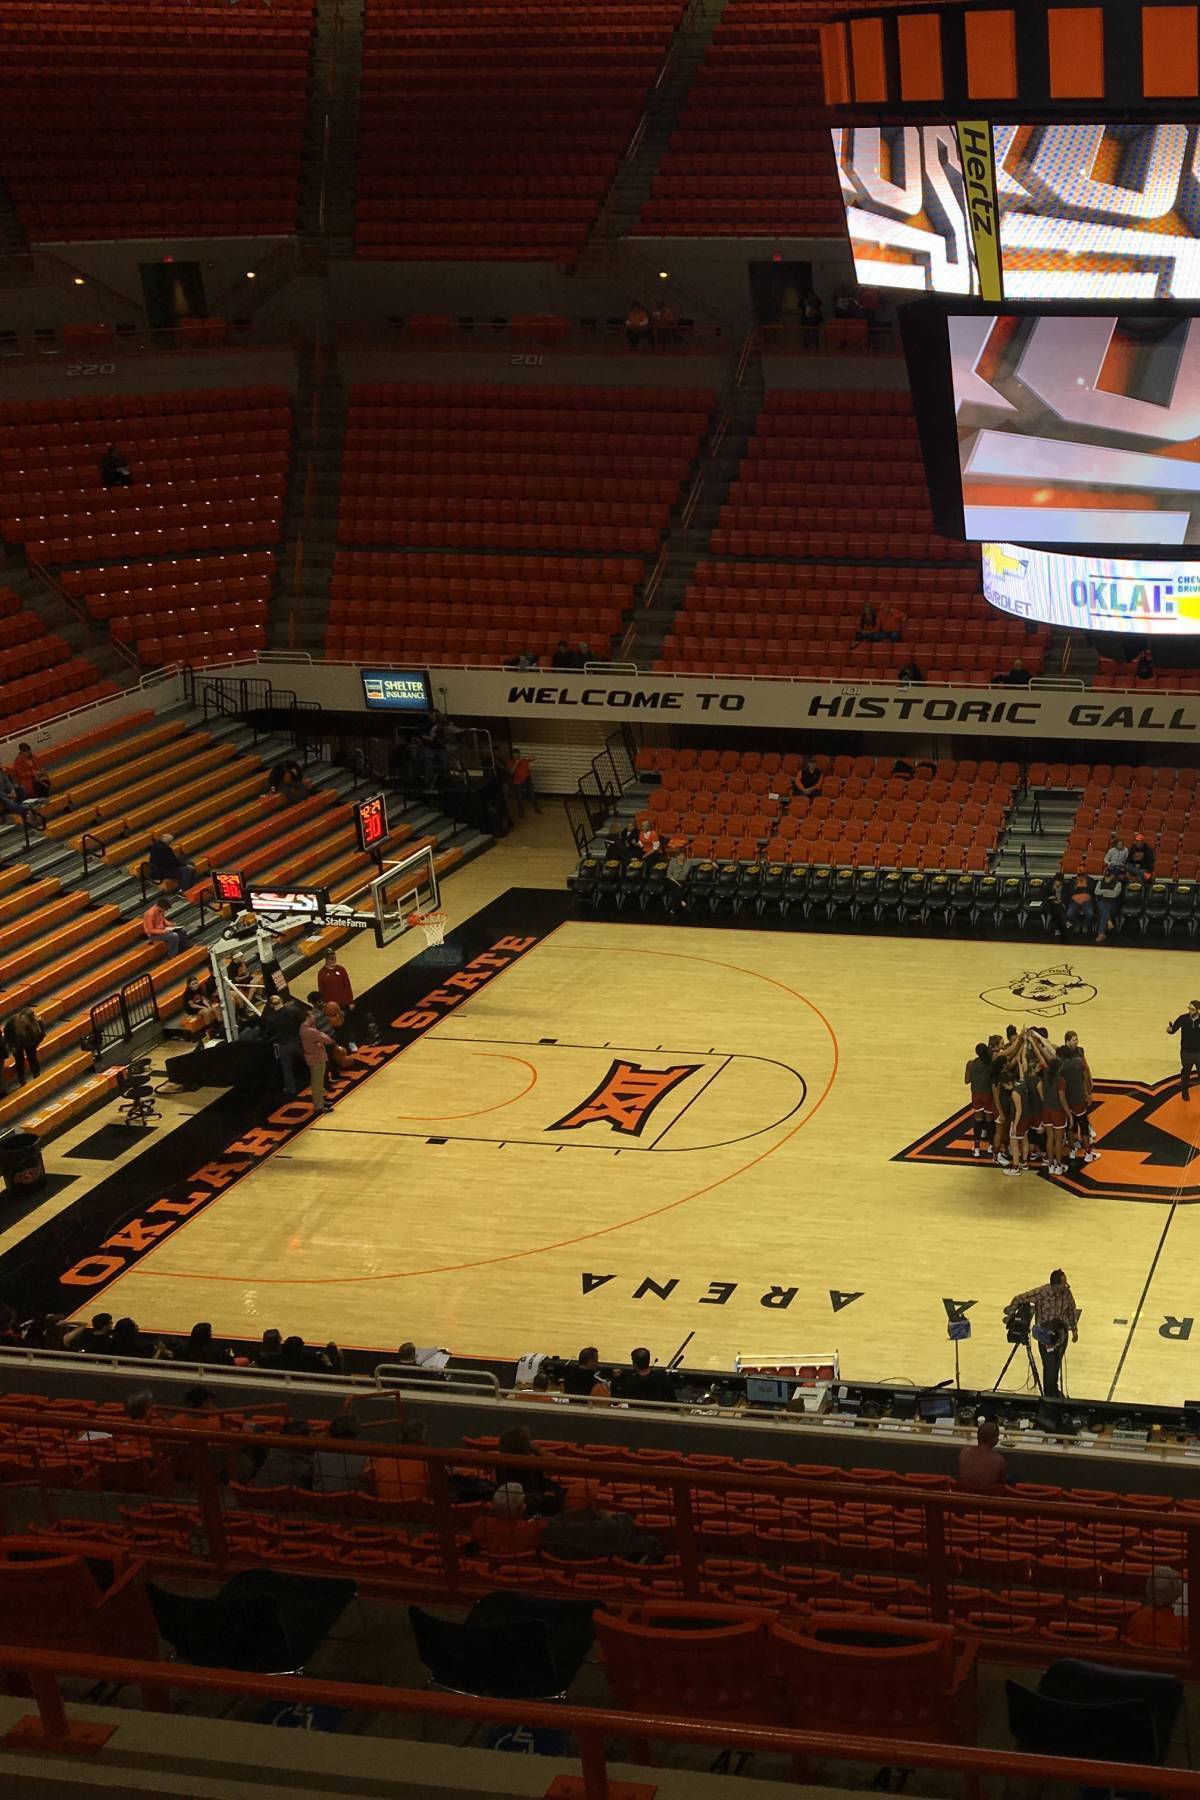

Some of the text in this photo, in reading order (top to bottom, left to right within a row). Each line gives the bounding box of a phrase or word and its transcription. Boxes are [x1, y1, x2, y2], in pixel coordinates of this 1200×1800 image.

[963, 127, 993, 237] Hertz
[384, 681, 423, 691] SHELTER
[508, 687, 745, 710] WELCOME TO
[808, 695, 1041, 725] HISTORIC
